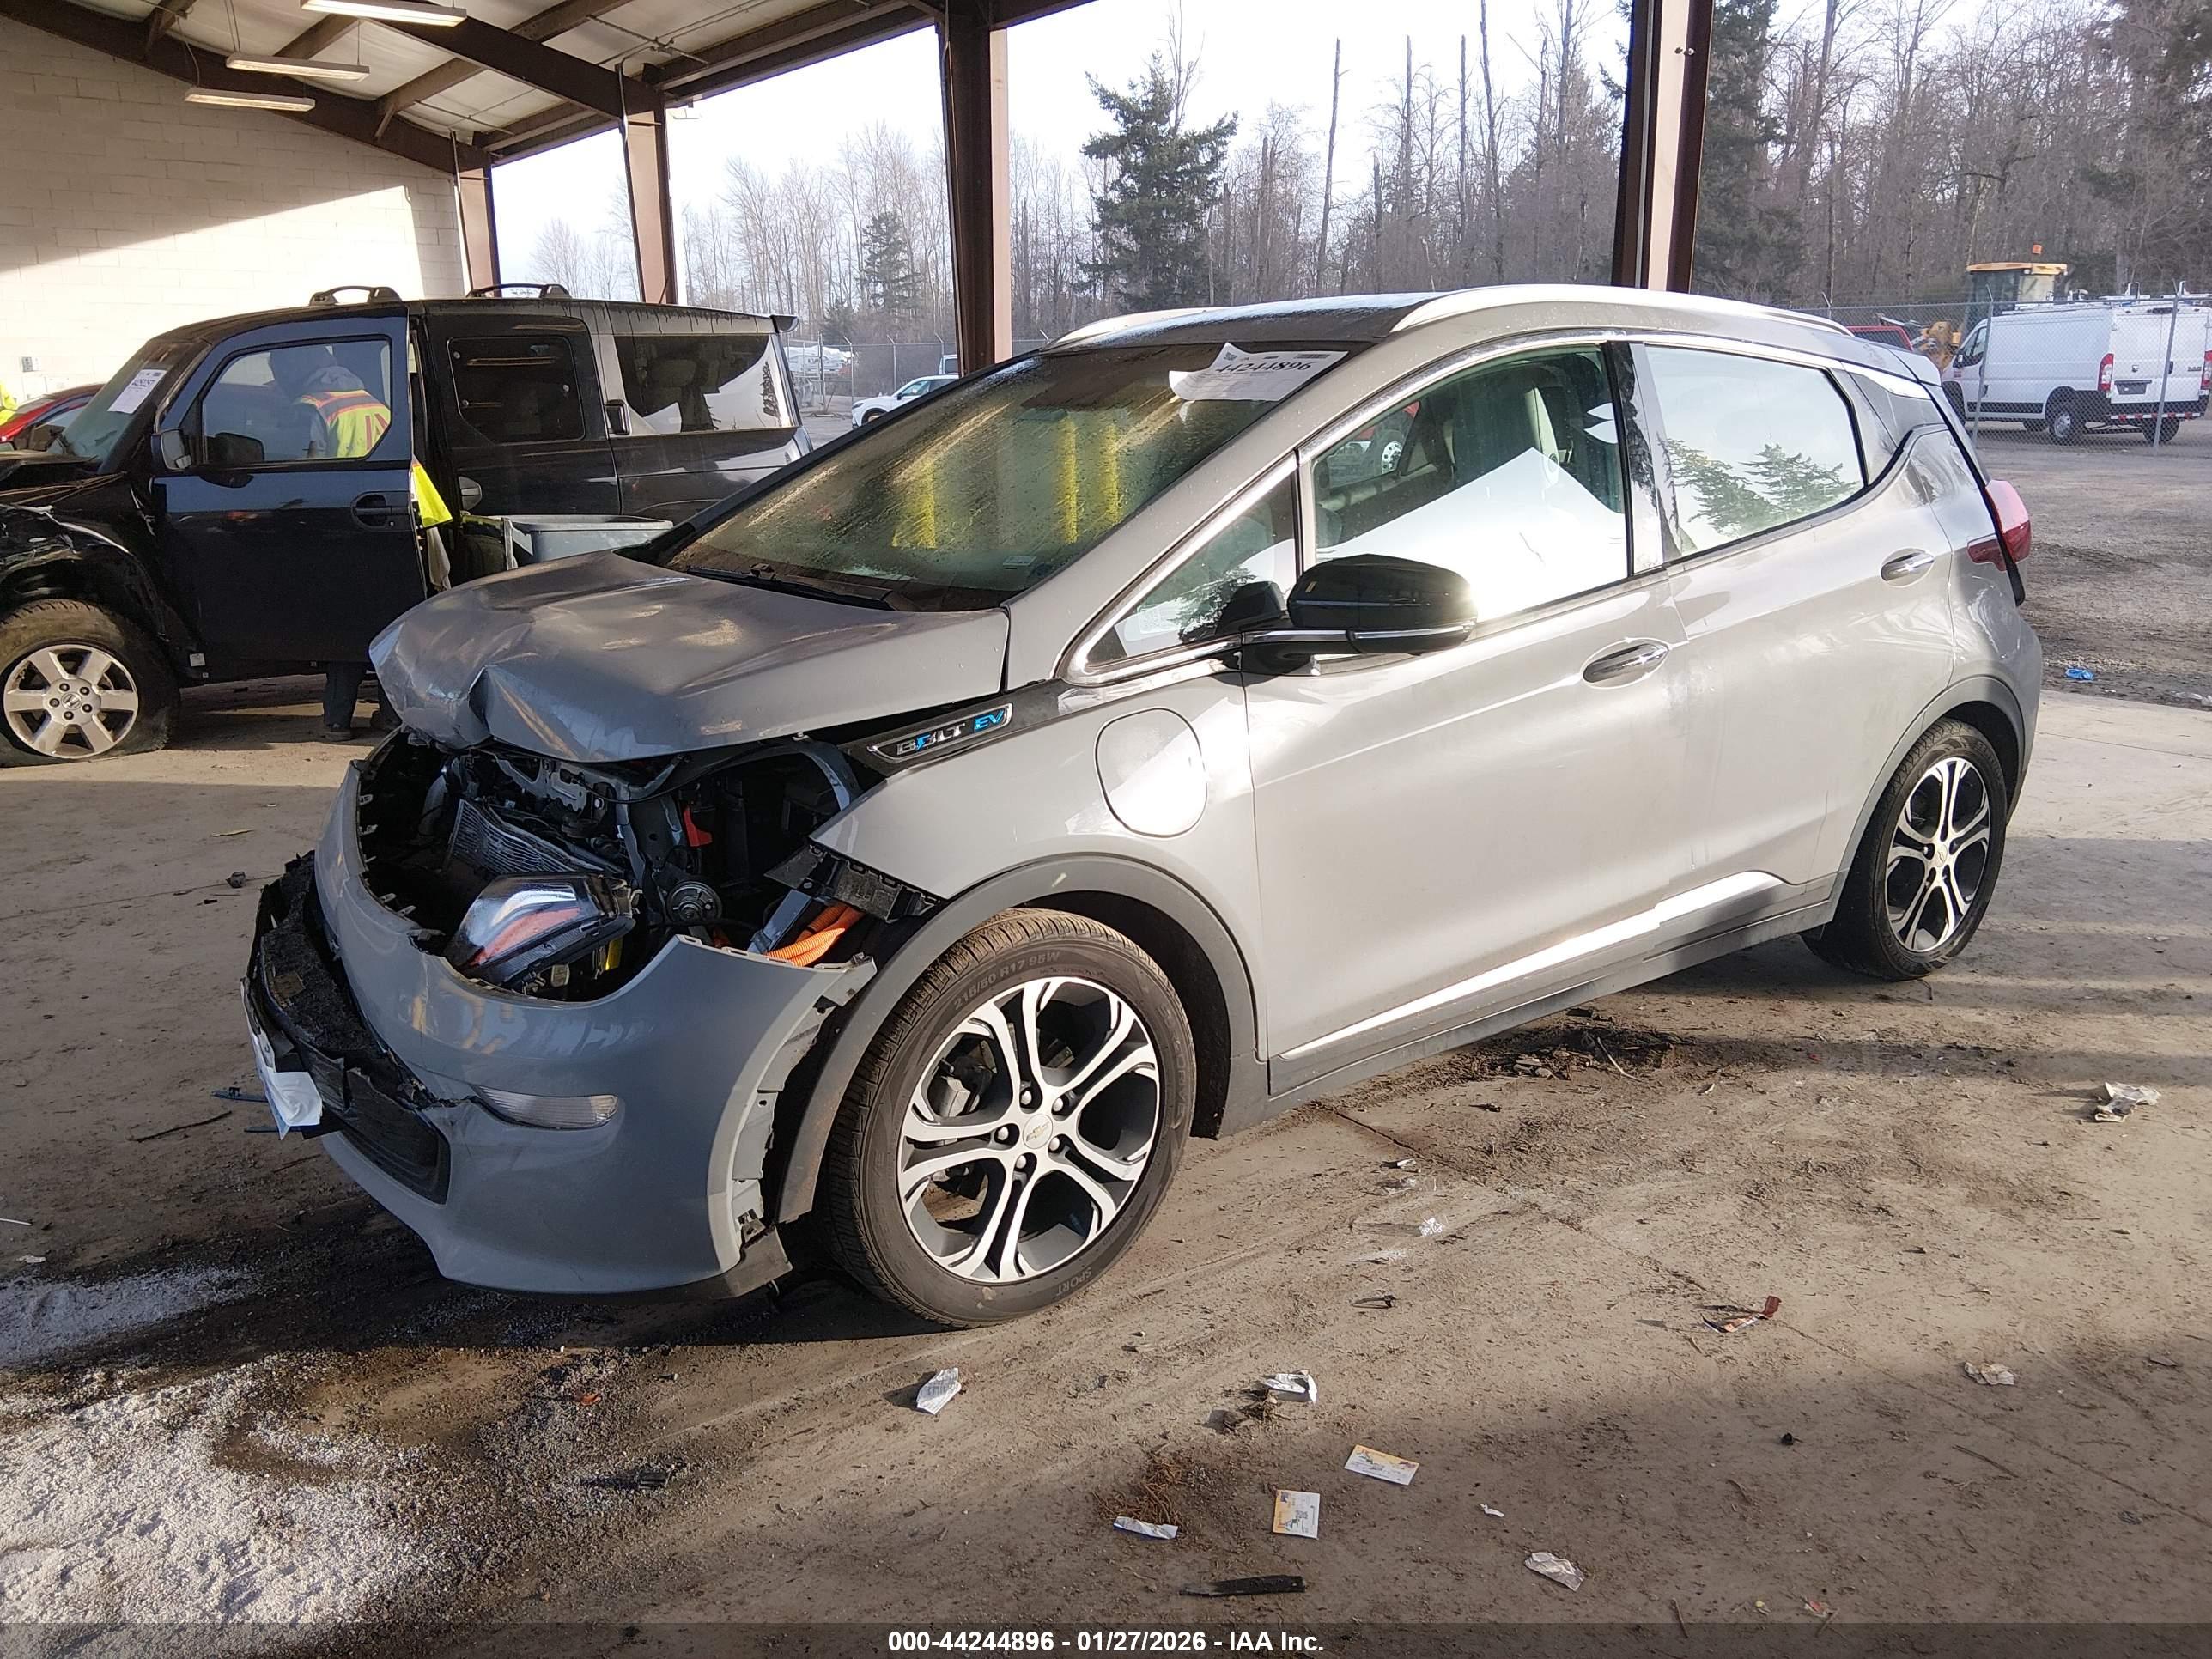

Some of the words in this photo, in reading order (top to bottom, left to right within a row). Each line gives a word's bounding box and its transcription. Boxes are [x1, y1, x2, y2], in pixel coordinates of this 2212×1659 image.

[1215, 362, 1313, 373] 44244896
[896, 723, 965, 756] BOLT
[973, 709, 1006, 731] EV
[1000, 959, 1026, 978] R17
[1056, 1267, 1092, 1297] SPORT
